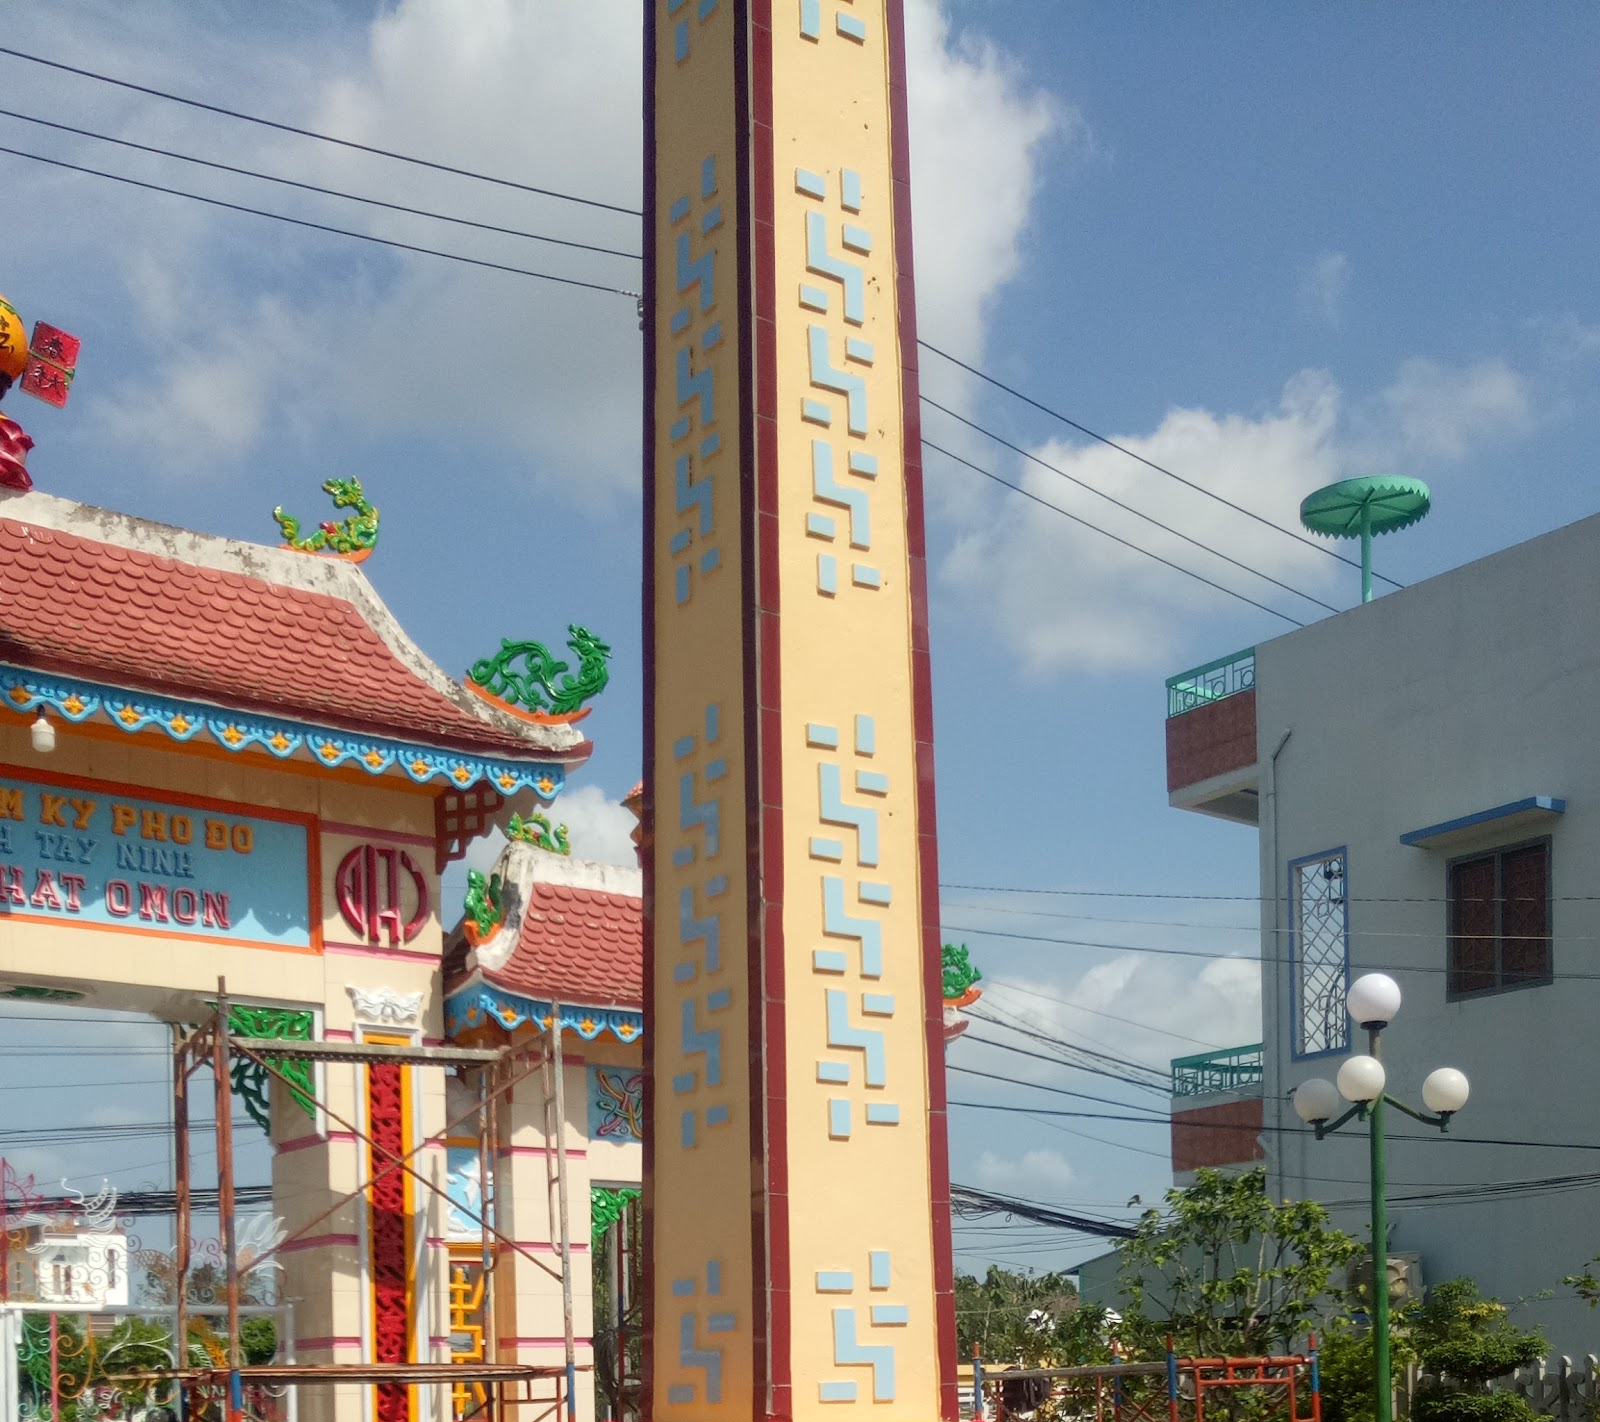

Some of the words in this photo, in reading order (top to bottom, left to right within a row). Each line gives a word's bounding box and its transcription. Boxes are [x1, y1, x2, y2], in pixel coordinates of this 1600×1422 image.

[40, 793, 97, 831] KY
[112, 804, 193, 845] PHO
[205, 819, 254, 854] DO
[35, 830, 97, 864] TAY
[117, 843, 195, 878] NINH
[105, 879, 231, 928] OMON
